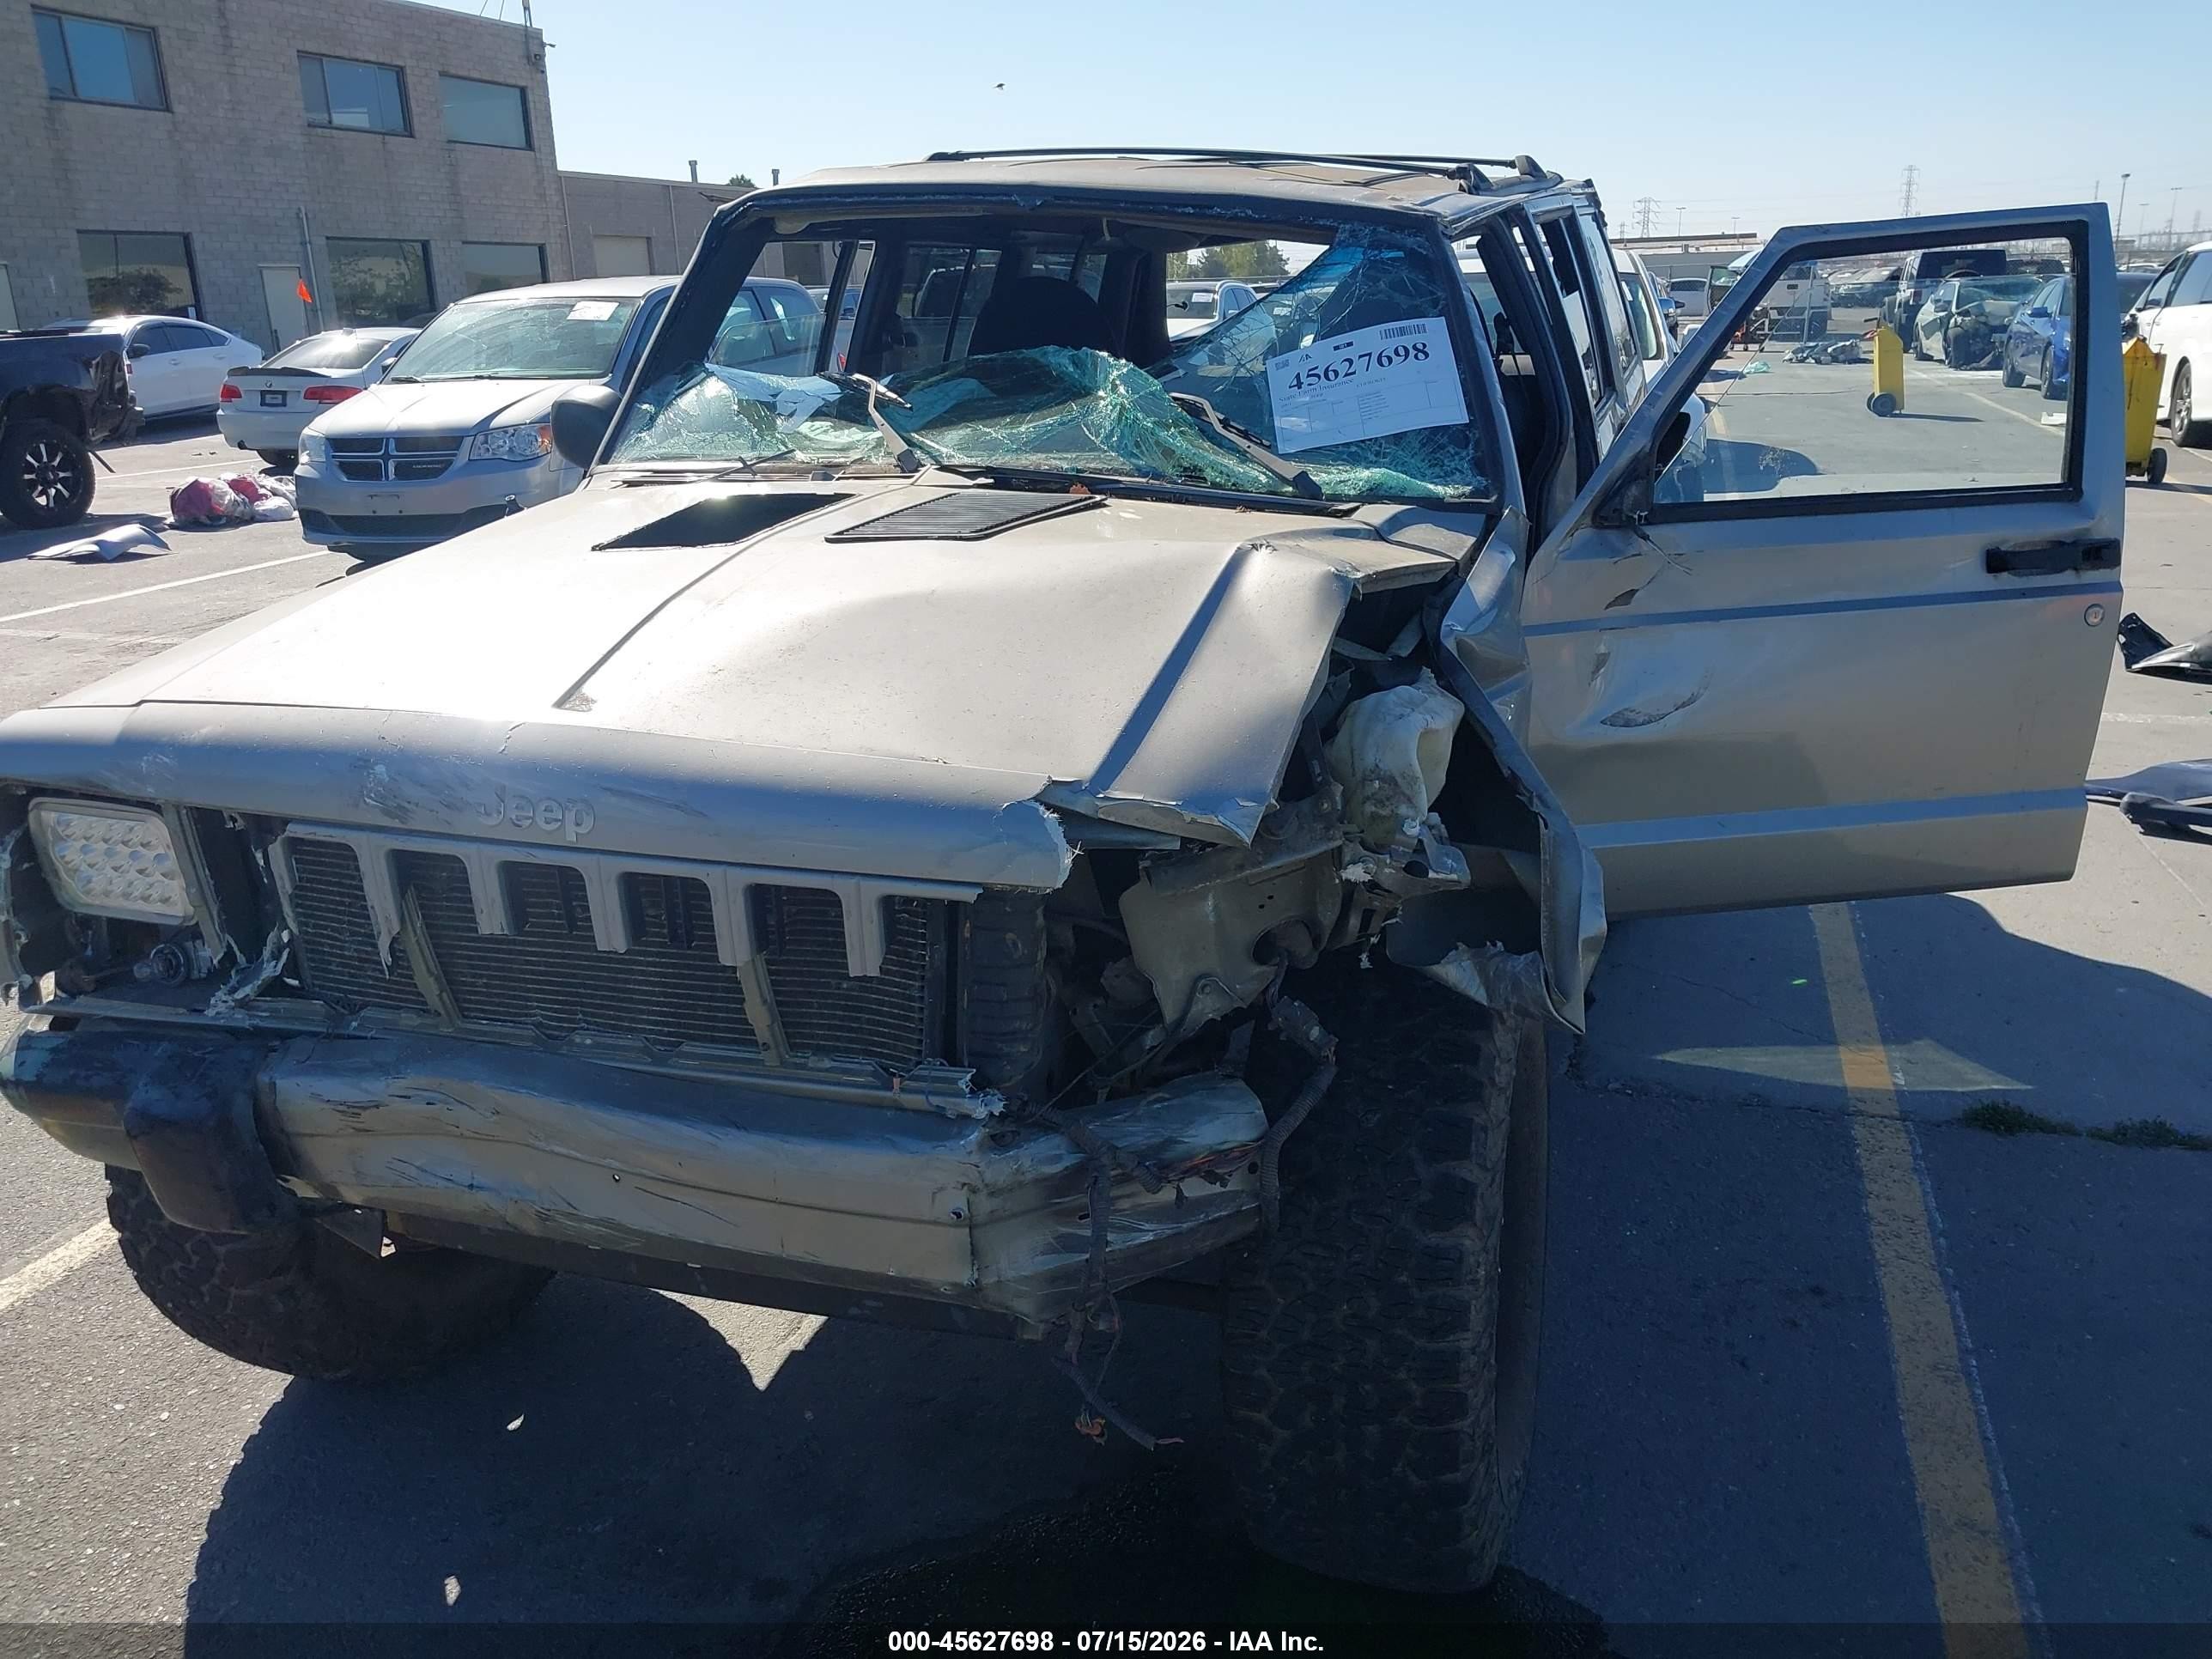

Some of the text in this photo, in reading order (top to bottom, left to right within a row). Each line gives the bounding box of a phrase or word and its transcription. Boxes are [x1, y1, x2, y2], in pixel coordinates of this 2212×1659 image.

[1288, 341, 1431, 391] 45627698
[1318, 378, 1354, 392] Insurance
[476, 783, 596, 843] Jeep
